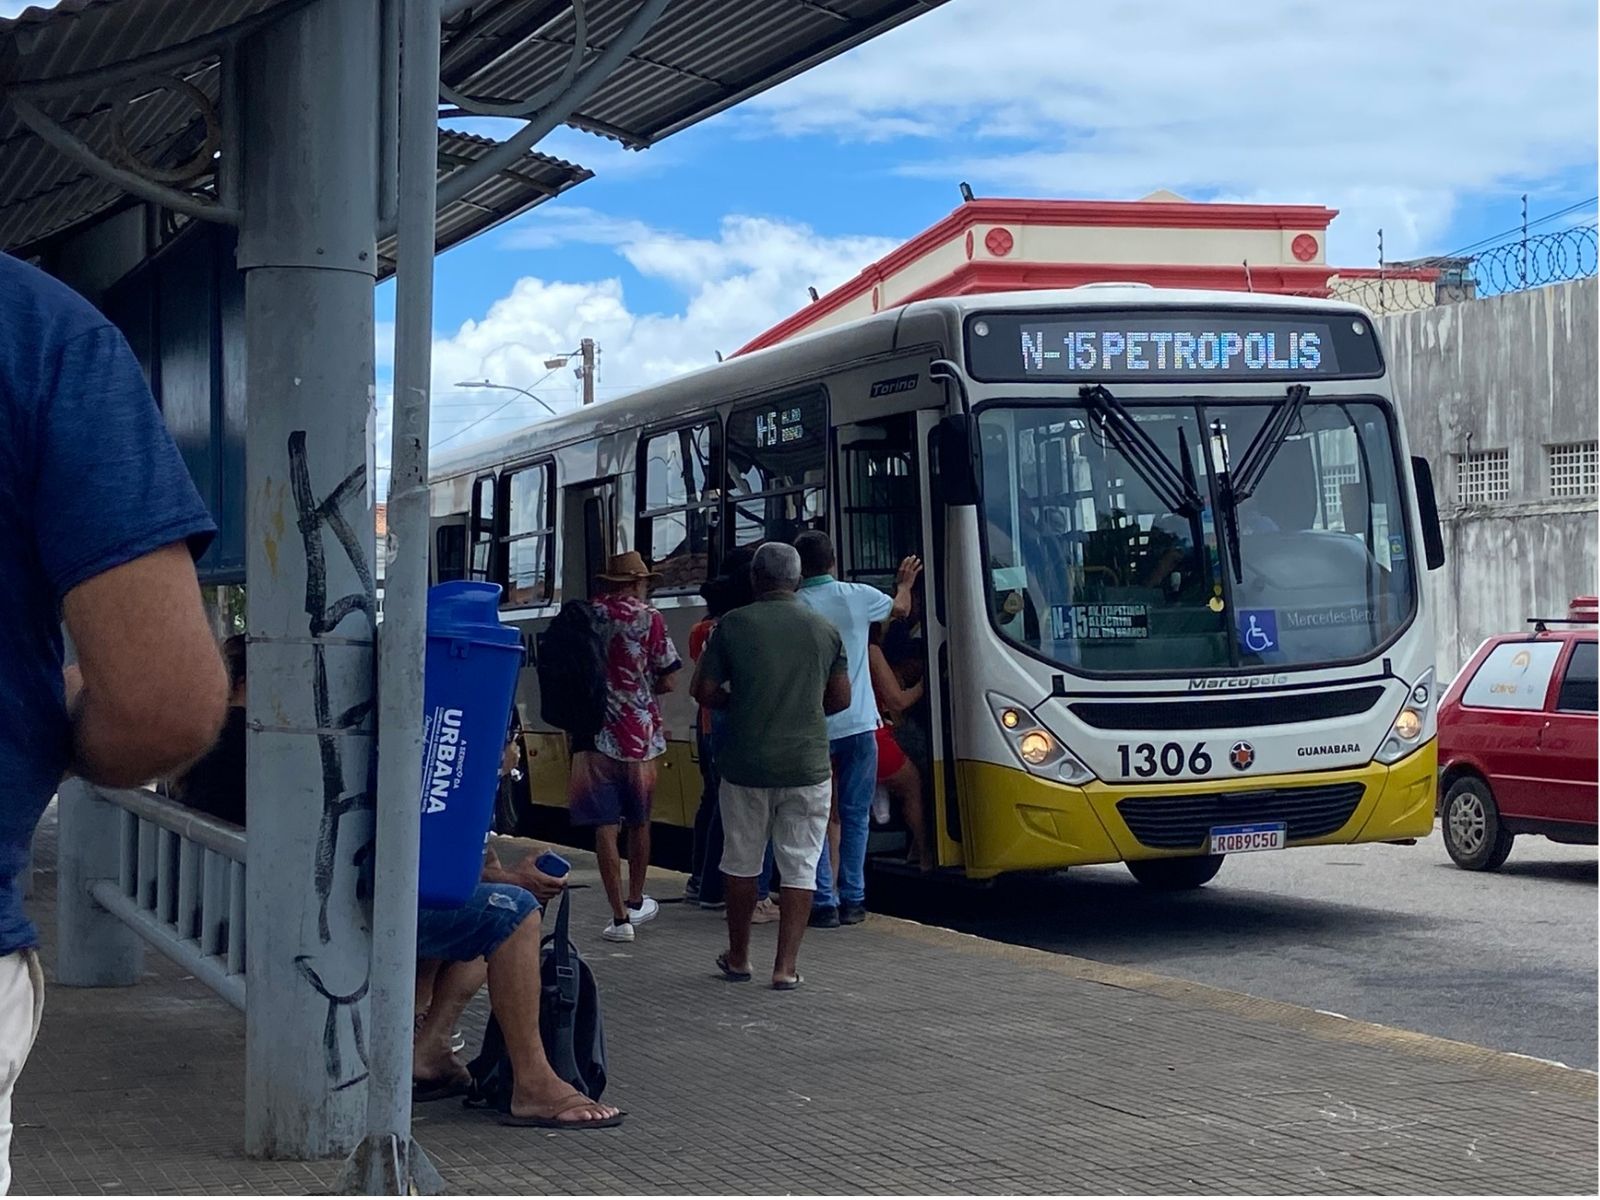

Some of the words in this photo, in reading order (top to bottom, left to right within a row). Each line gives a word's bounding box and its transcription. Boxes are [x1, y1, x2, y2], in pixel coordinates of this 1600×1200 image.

[1022, 332, 1096, 369] N-15
[1102, 332, 1321, 369] PETROPOLIS
[873, 379, 916, 396] Torino
[1052, 606, 1088, 639] N-15
[1188, 674, 1288, 690] Marcopolo
[427, 709, 463, 813] URBANA
[1117, 741, 1212, 777] 1306
[1297, 743, 1361, 757] GUANABARA
